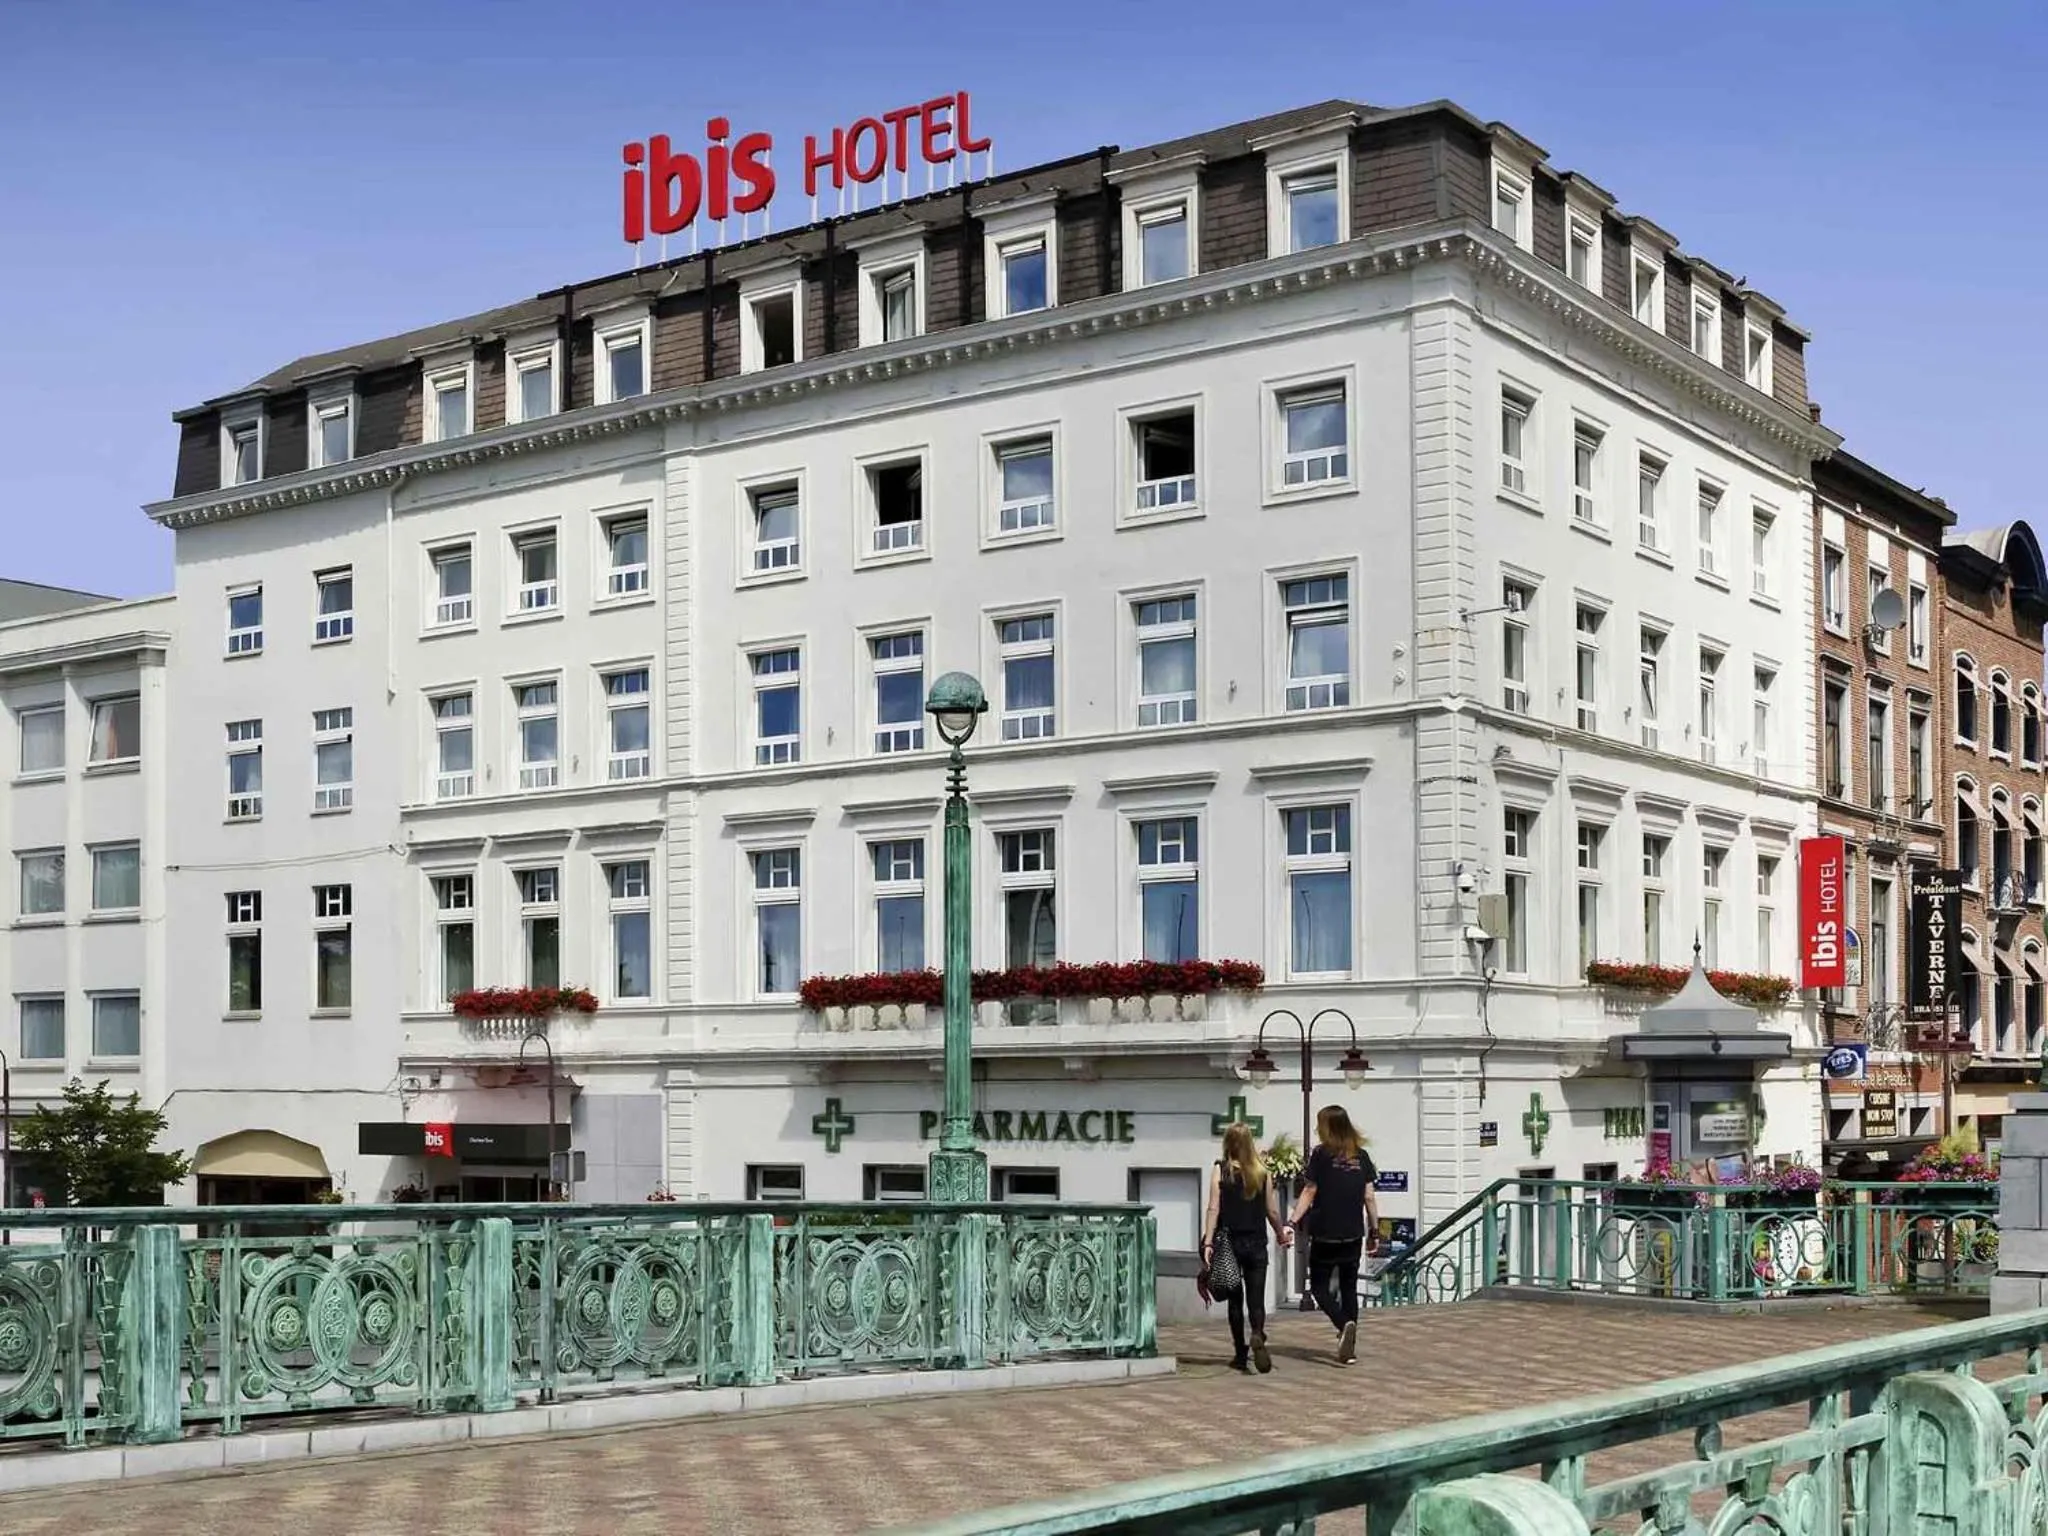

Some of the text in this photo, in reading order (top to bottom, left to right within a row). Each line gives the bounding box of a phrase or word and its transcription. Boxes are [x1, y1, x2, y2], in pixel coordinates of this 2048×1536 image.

[623, 90, 992, 244] ibis HOTEL
[1913, 884, 1960, 895] Président
[1930, 875, 1943, 885] Le
[1811, 857, 1837, 968] ibis HOTEL
[1928, 895, 1946, 999] TAVERNE
[424, 1131, 444, 1147] ibis
[919, 1110, 1136, 1143] PARMACIE
